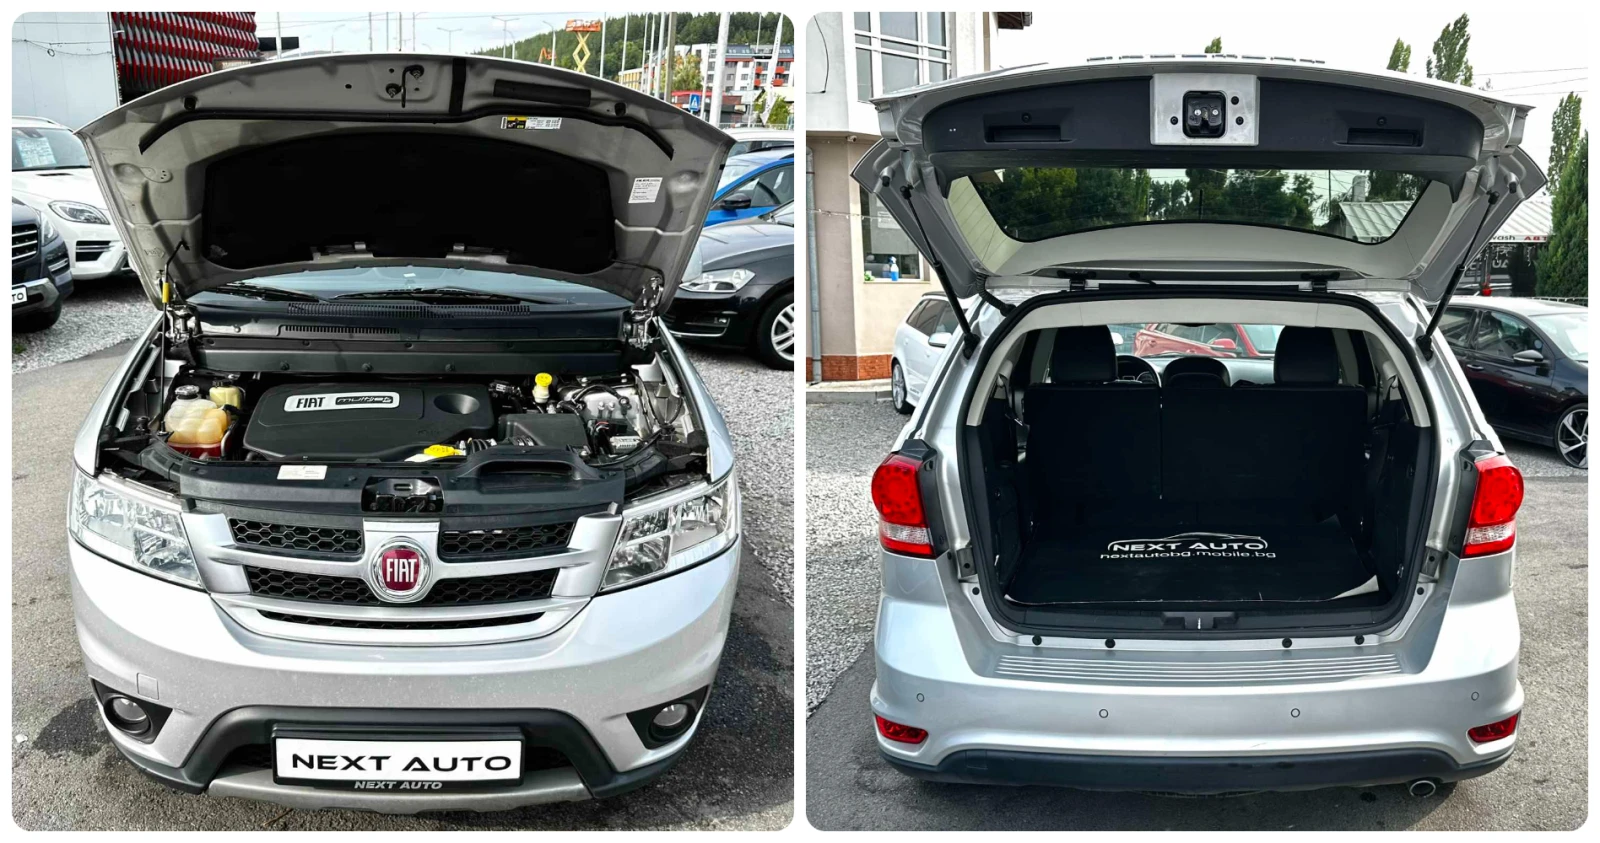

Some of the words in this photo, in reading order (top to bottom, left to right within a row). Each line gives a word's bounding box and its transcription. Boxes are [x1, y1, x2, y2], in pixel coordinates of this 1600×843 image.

[296, 397, 327, 409] FIAT
[1113, 543, 1182, 551] NEXT
[1188, 542, 1265, 551] AUTO
[1100, 550, 1277, 559] nextautobg.mobile.bg
[386, 558, 418, 583] FIAT
[292, 753, 392, 771] NEXT
[401, 755, 512, 772] AUTO
[354, 781, 397, 790] NEXT
[400, 781, 444, 790] AUTO
